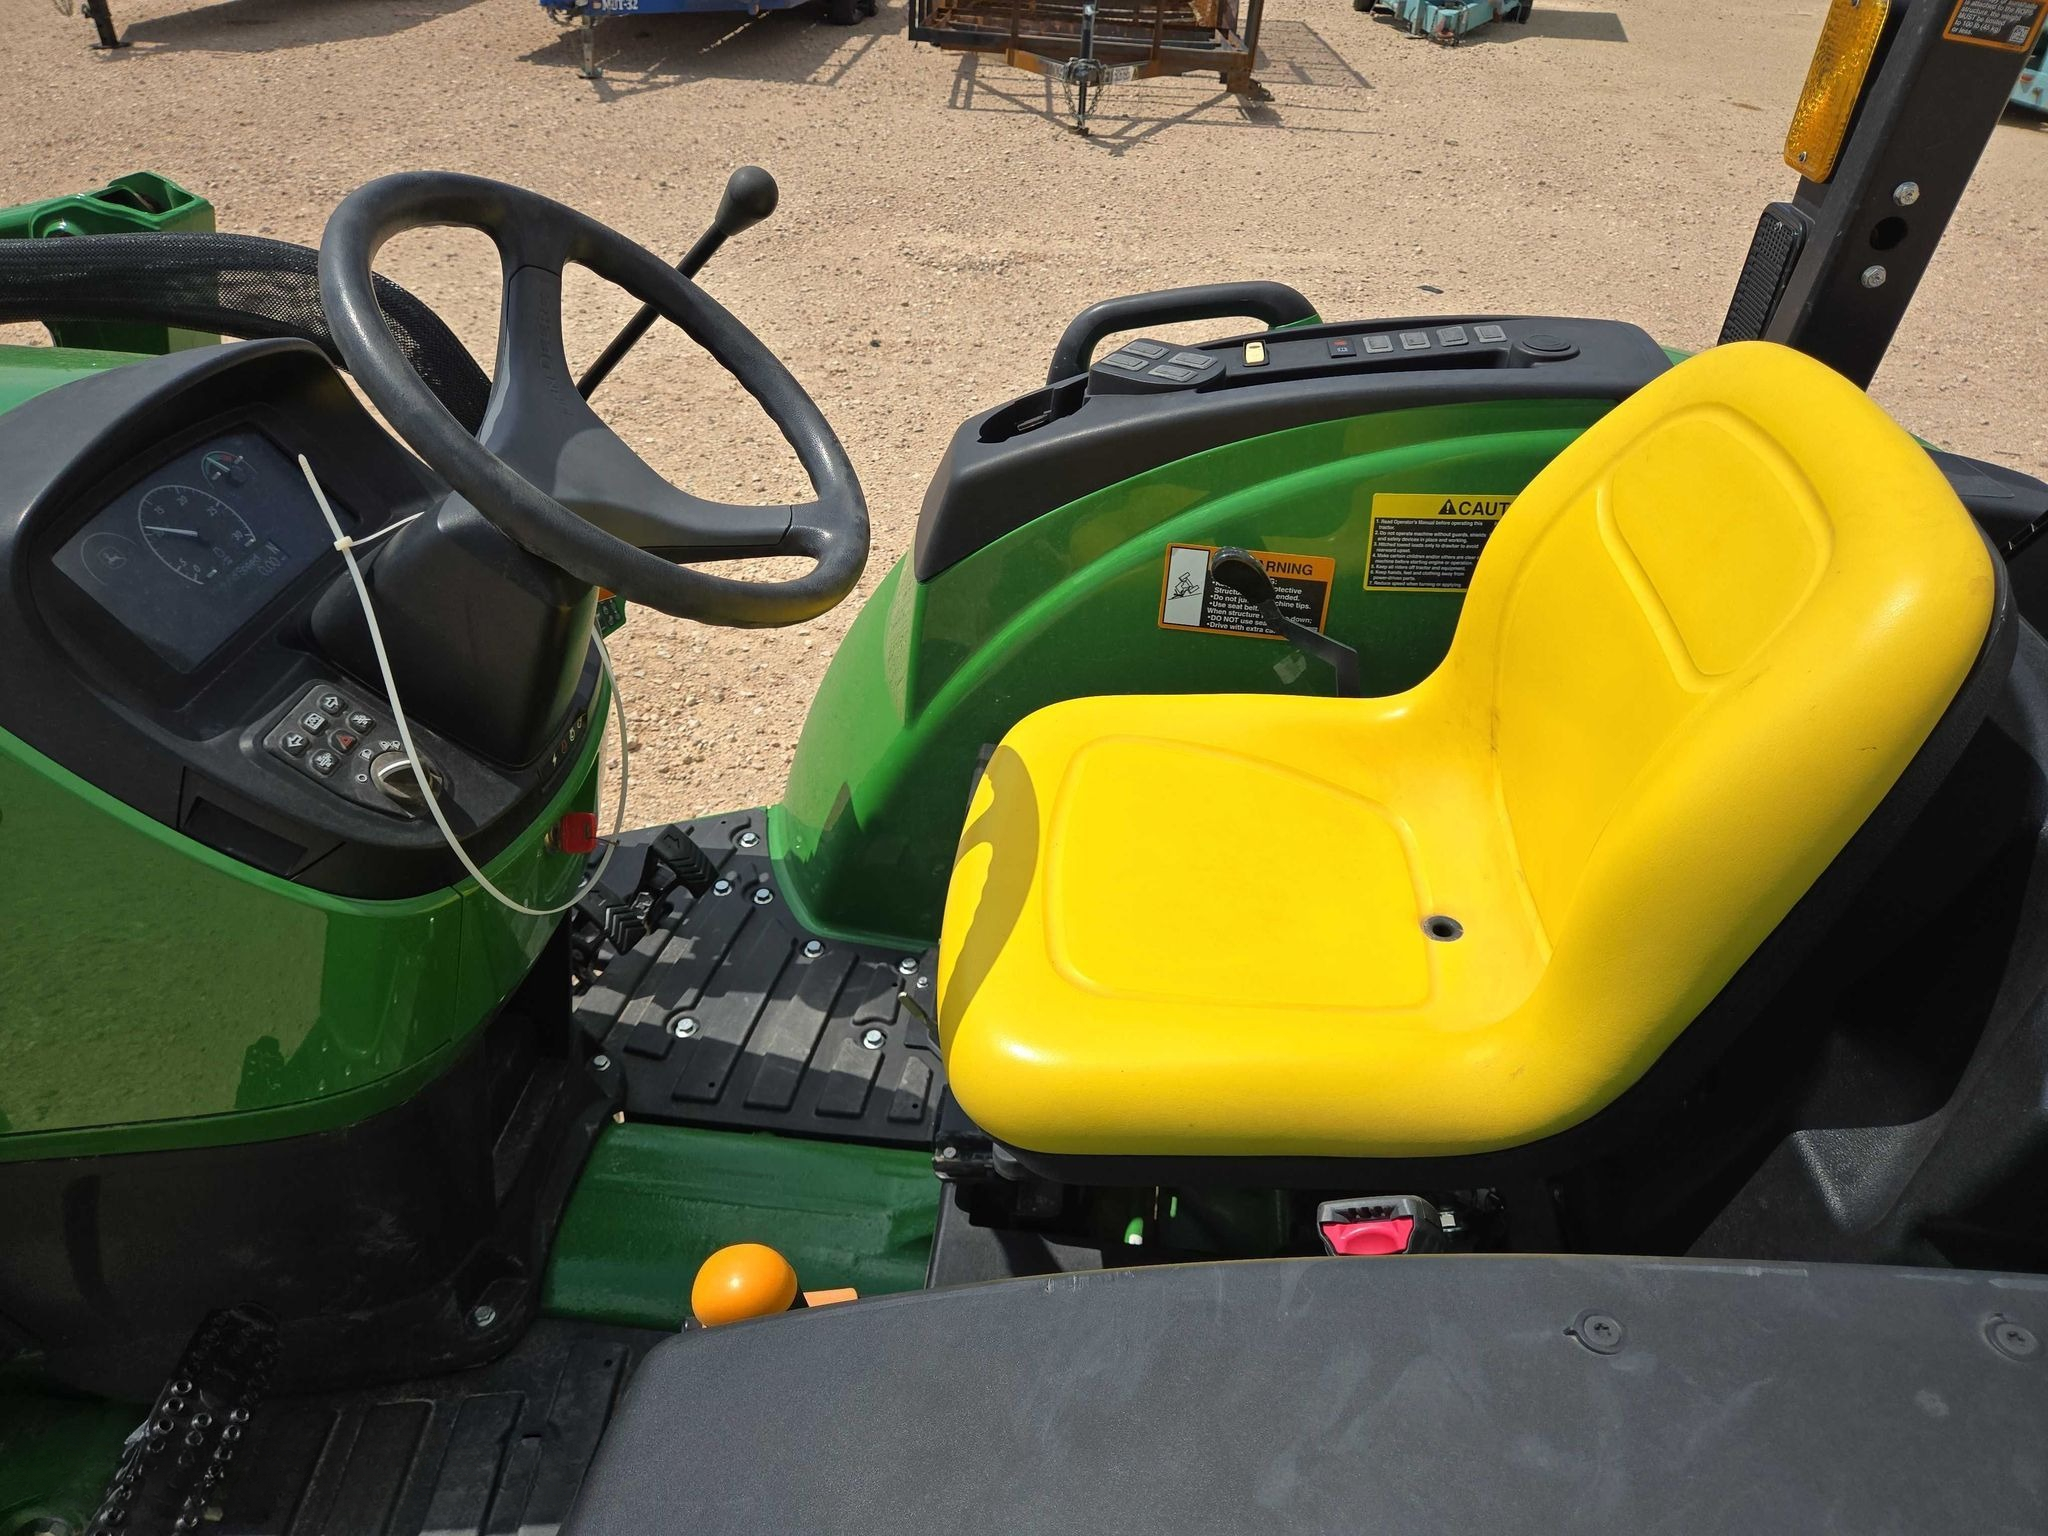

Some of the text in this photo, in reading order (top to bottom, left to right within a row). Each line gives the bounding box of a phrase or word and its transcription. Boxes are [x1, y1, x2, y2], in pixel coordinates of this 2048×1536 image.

[1458, 501, 1509, 516] CAUT
[1260, 559, 1313, 576] RNING
[1275, 600, 1295, 608] chine
[1295, 602, 1312, 610] tips.
[1207, 607, 1227, 615] When
[1228, 610, 1260, 619] structure
